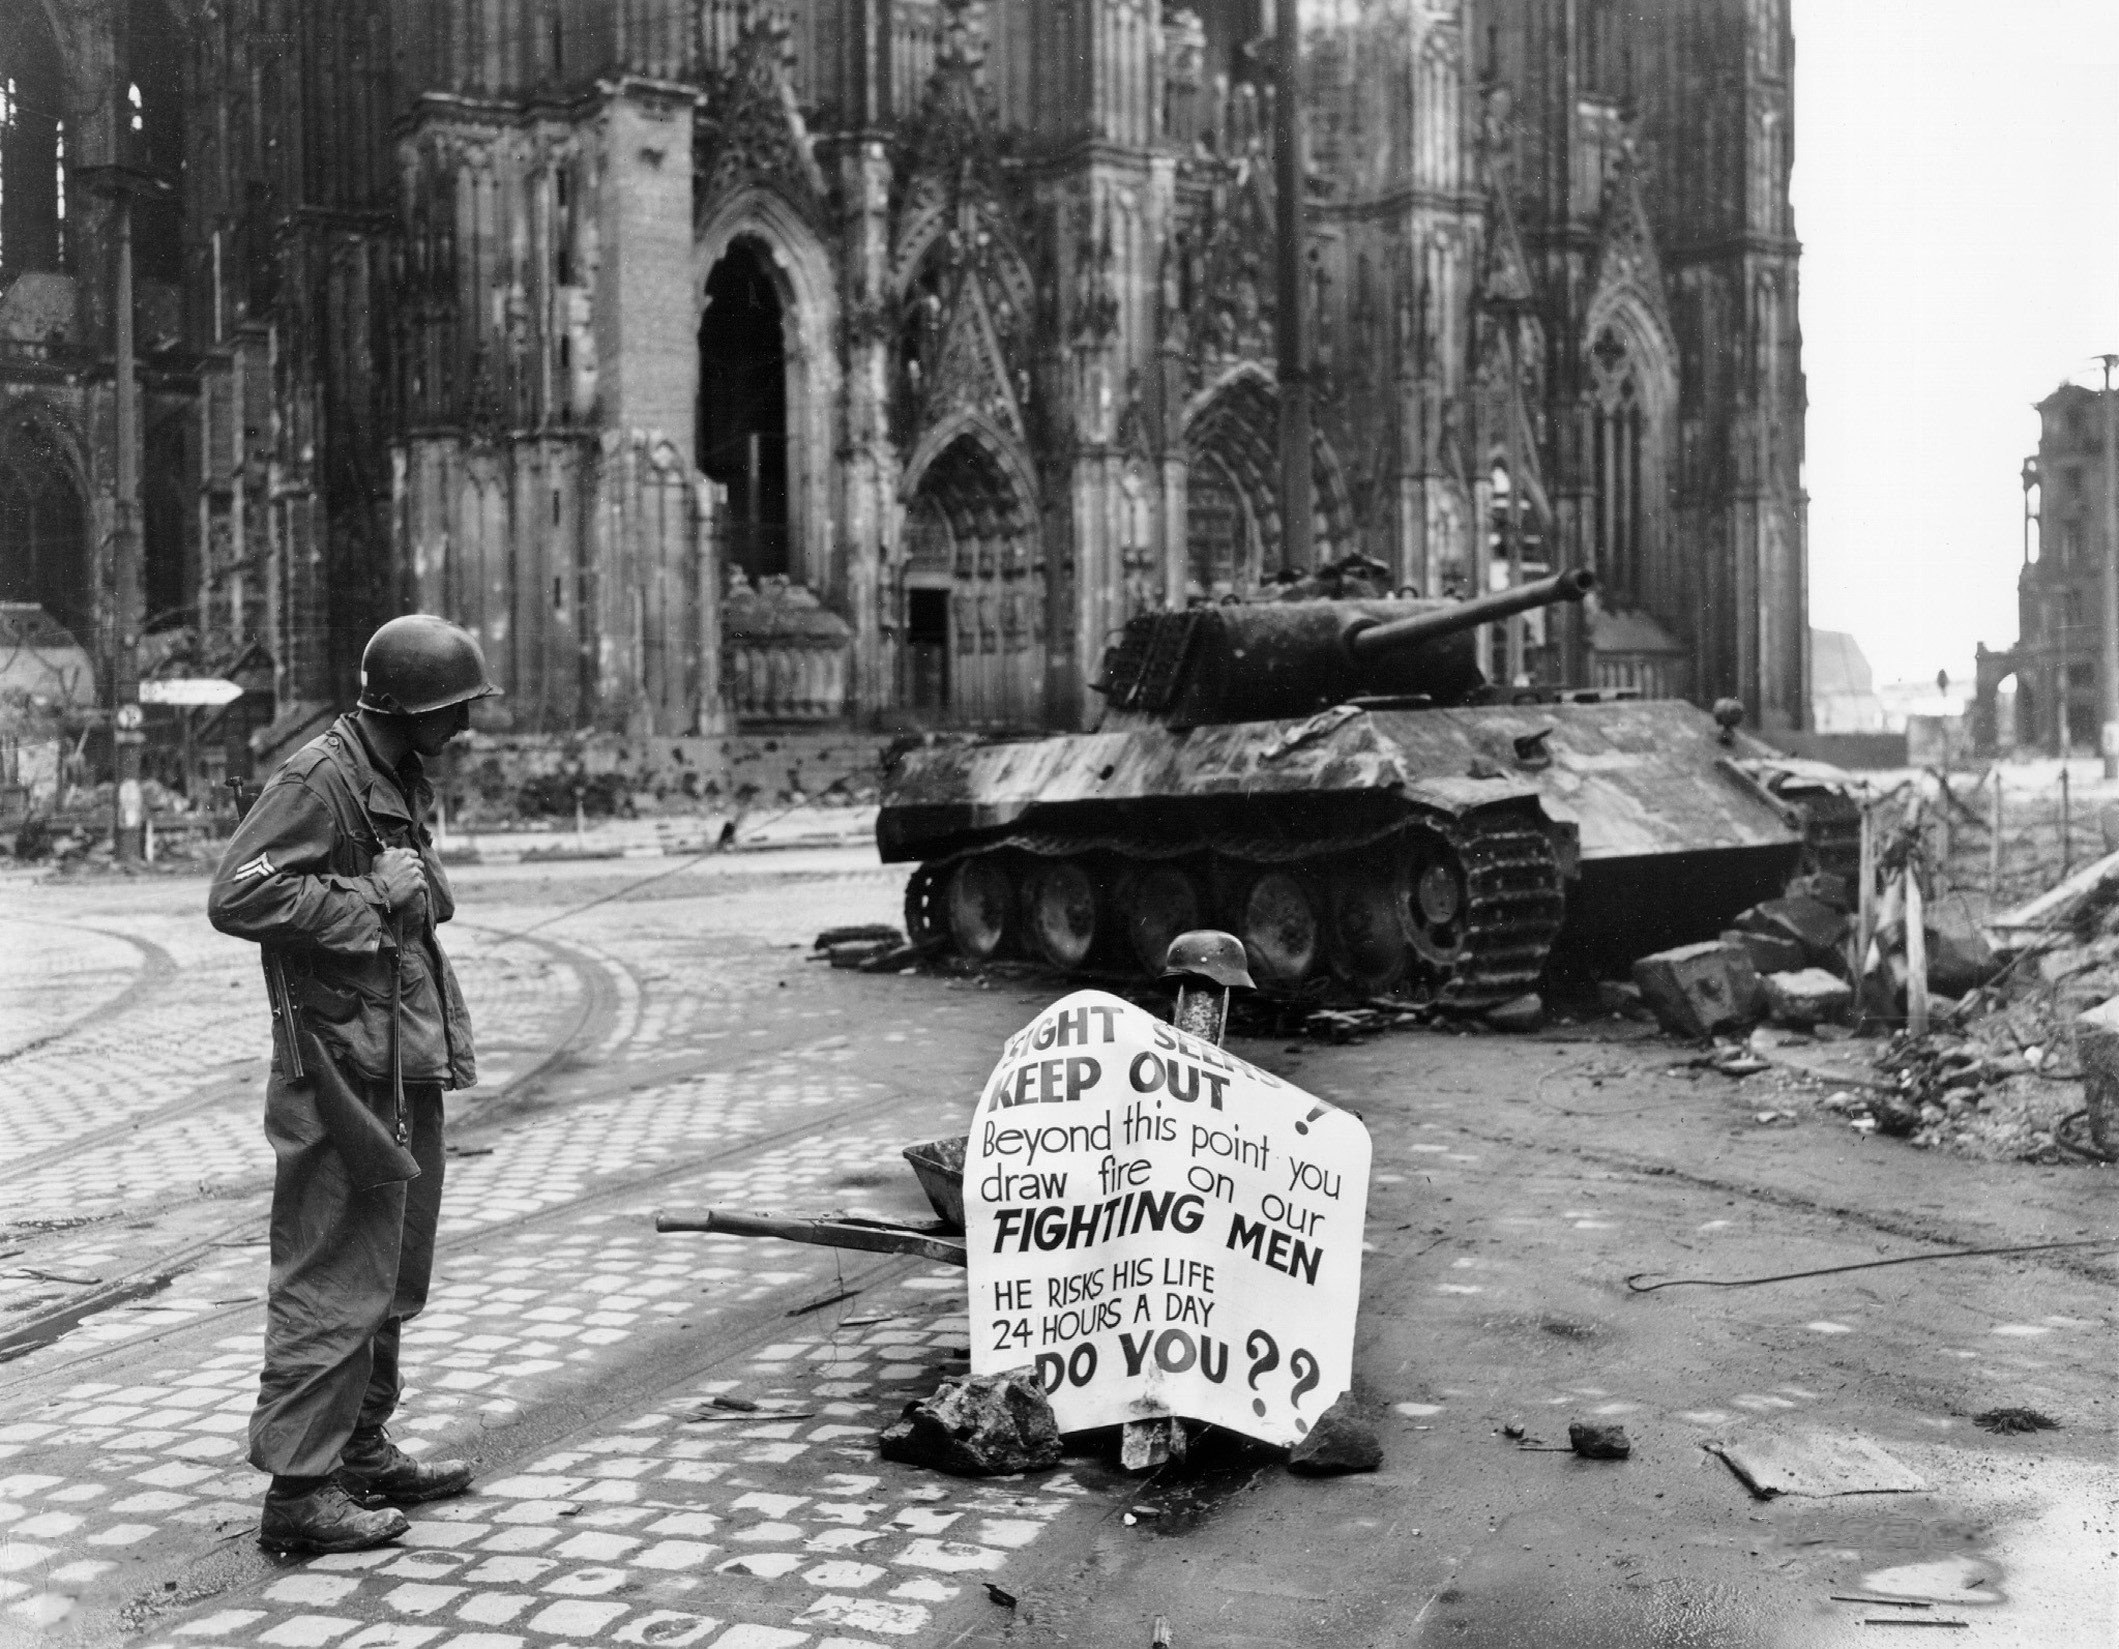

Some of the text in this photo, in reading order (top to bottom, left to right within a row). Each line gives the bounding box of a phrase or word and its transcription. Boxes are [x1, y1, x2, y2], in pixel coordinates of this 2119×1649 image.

[987, 1056, 1103, 1114] KEEP
[1128, 1050, 1231, 1112] OUT
[1152, 1022, 1281, 1089] SEE
[982, 1099, 1342, 1201] Beyond this point you
[980, 1153, 1326, 1238] draw fire on our
[992, 1189, 1325, 1287] FIGHTING MEN
[993, 1257, 1216, 1312] HE RISKS HIS LIFE
[991, 1292, 1216, 1352] 24 HOURS A DAY
[1034, 1341, 1099, 1396] DO
[1117, 1328, 1229, 1385] YOU
